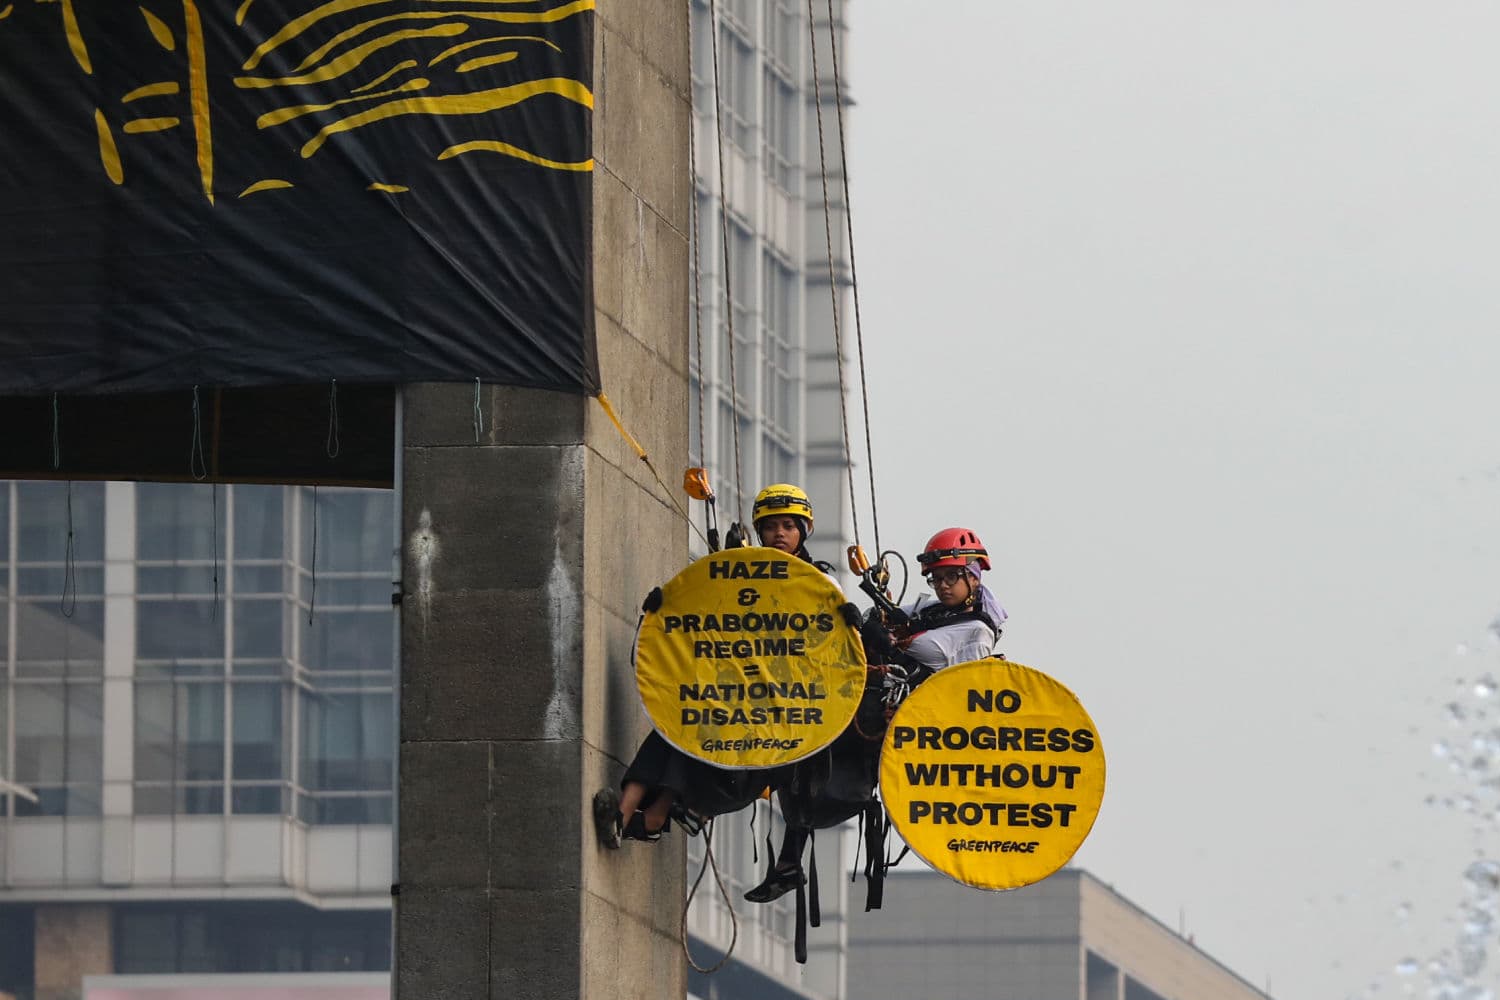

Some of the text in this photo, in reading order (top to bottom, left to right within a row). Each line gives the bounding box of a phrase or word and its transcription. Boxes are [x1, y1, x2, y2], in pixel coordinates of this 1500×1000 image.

[709, 560, 789, 580] HAZE
[737, 588, 761, 606] &
[664, 611, 834, 633] PRABOWO'S
[694, 638, 806, 659] REGIME
[679, 682, 826, 701] NATIONAL
[967, 688, 1022, 713] NO
[681, 707, 824, 726] DISASTER
[701, 738, 804, 753] GREENPEACE
[893, 725, 1095, 753] PROGRESS
[904, 762, 1081, 789] WITHOUT
[909, 800, 1077, 829] PROTEST
[947, 838, 1040, 854] GREENPEACE
